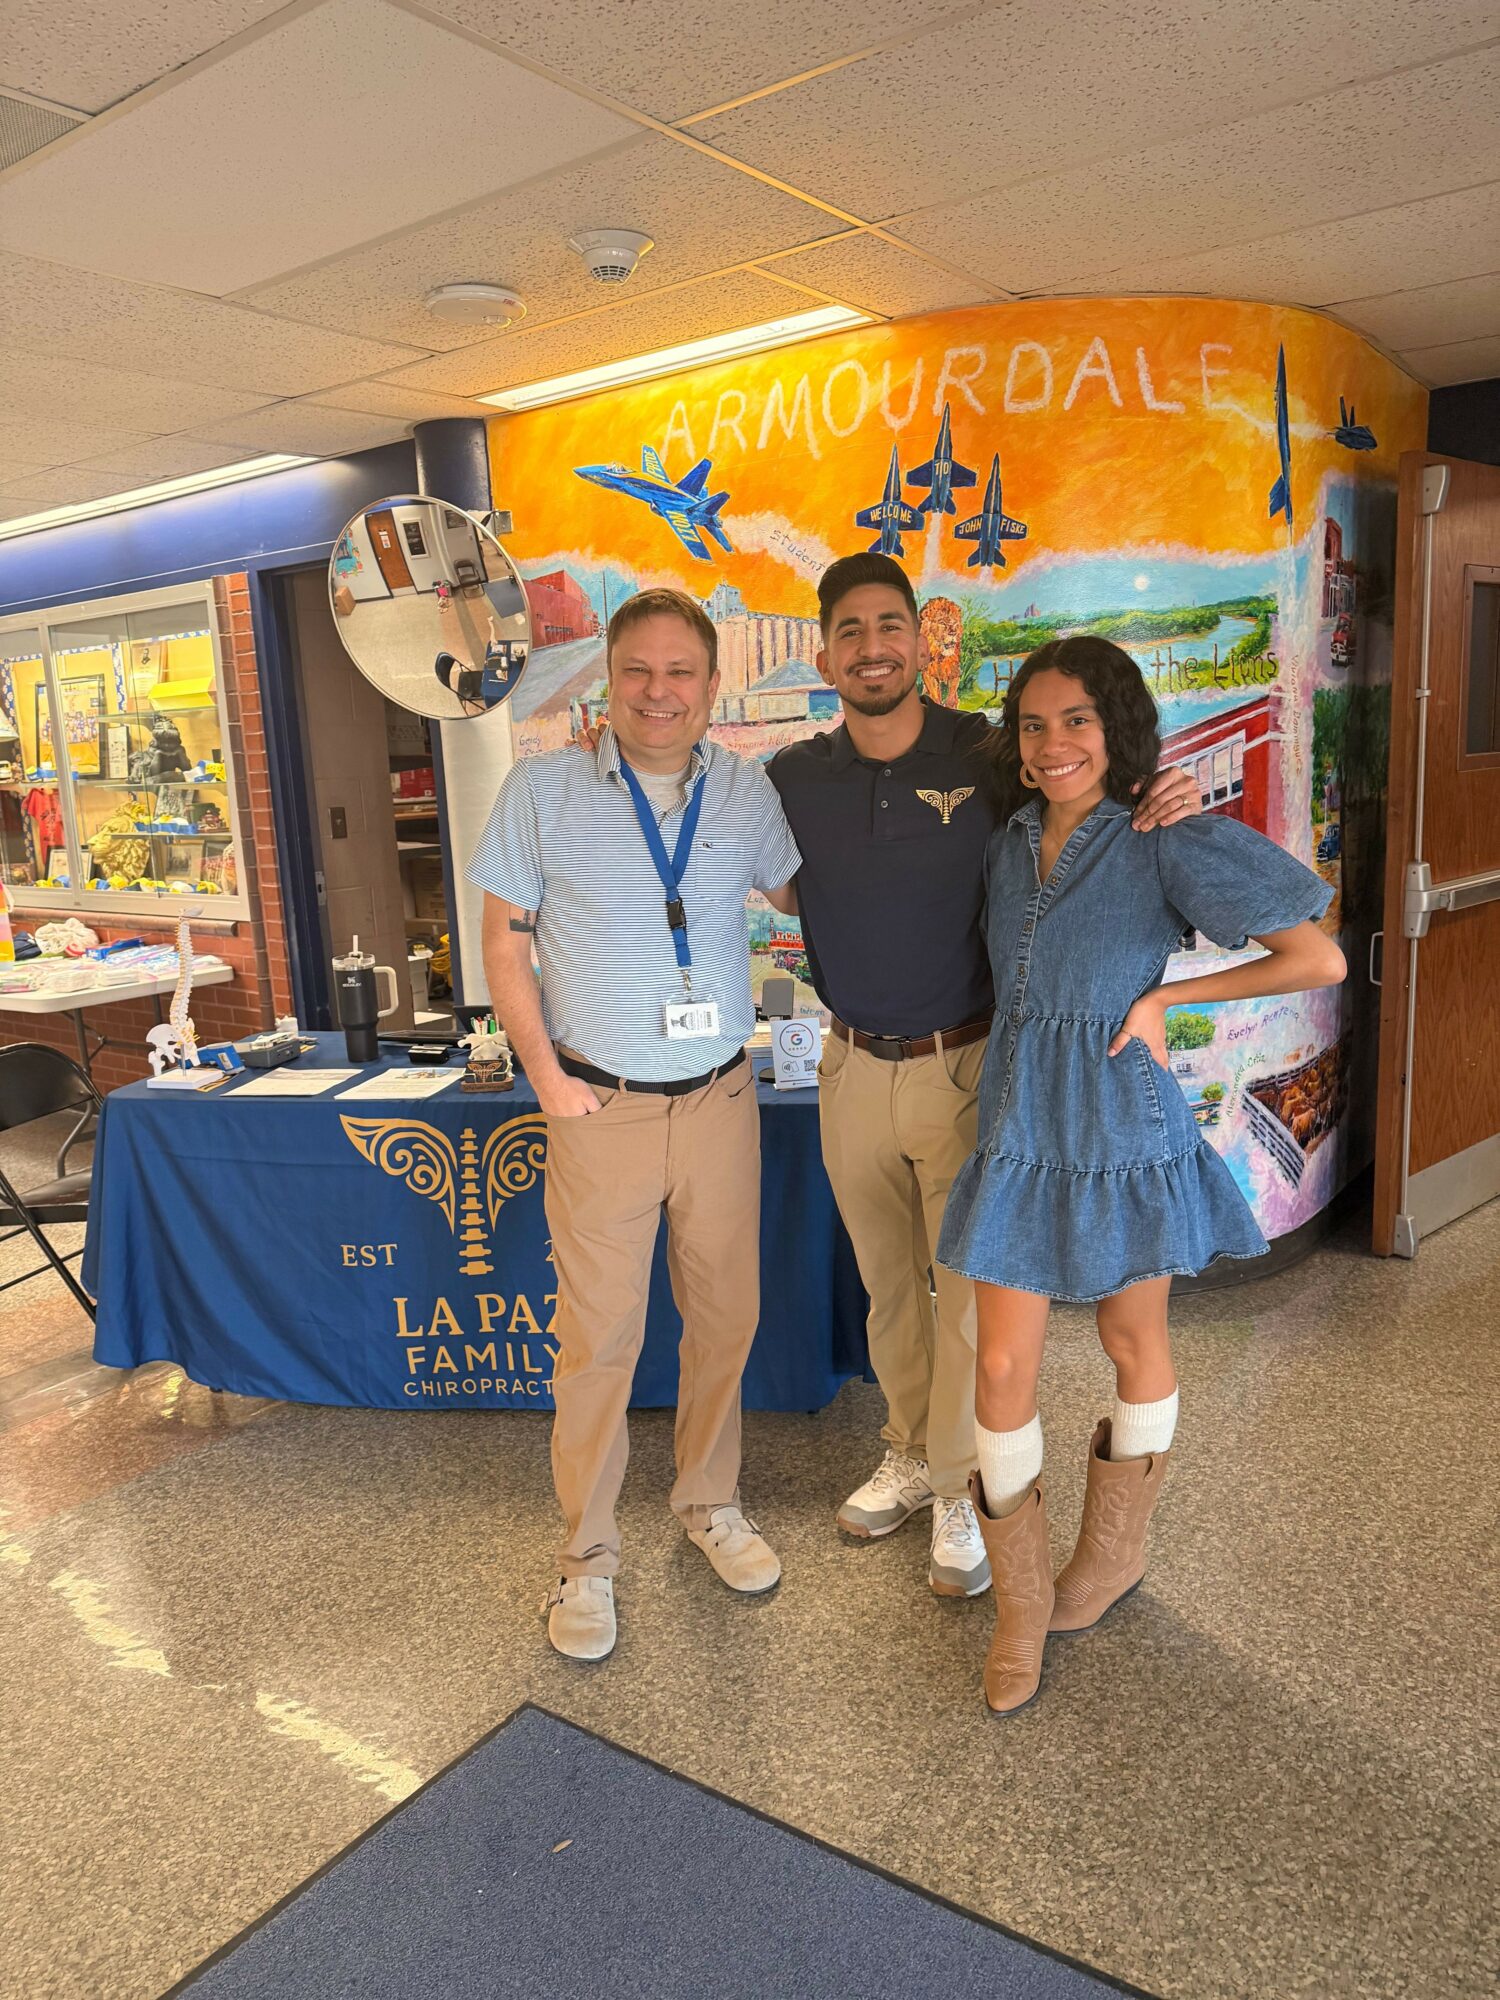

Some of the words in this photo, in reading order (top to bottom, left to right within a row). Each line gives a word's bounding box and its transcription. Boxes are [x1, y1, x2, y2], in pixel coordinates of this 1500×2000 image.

[661, 336, 1236, 460] ARMOURDALE
[643, 449, 666, 480] PRIDE
[935, 462, 950, 476] TO
[665, 509, 701, 543] LION
[870, 503, 912, 524] WELCOME
[958, 518, 983, 535] JOHN
[1000, 519, 1026, 535] FISKE
[1150, 646, 1199, 688] the
[1213, 643, 1277, 683] Lions
[340, 1243, 398, 1268] EST
[393, 1296, 464, 1338] LA
[403, 1378, 553, 1397] CHIROPRACT
